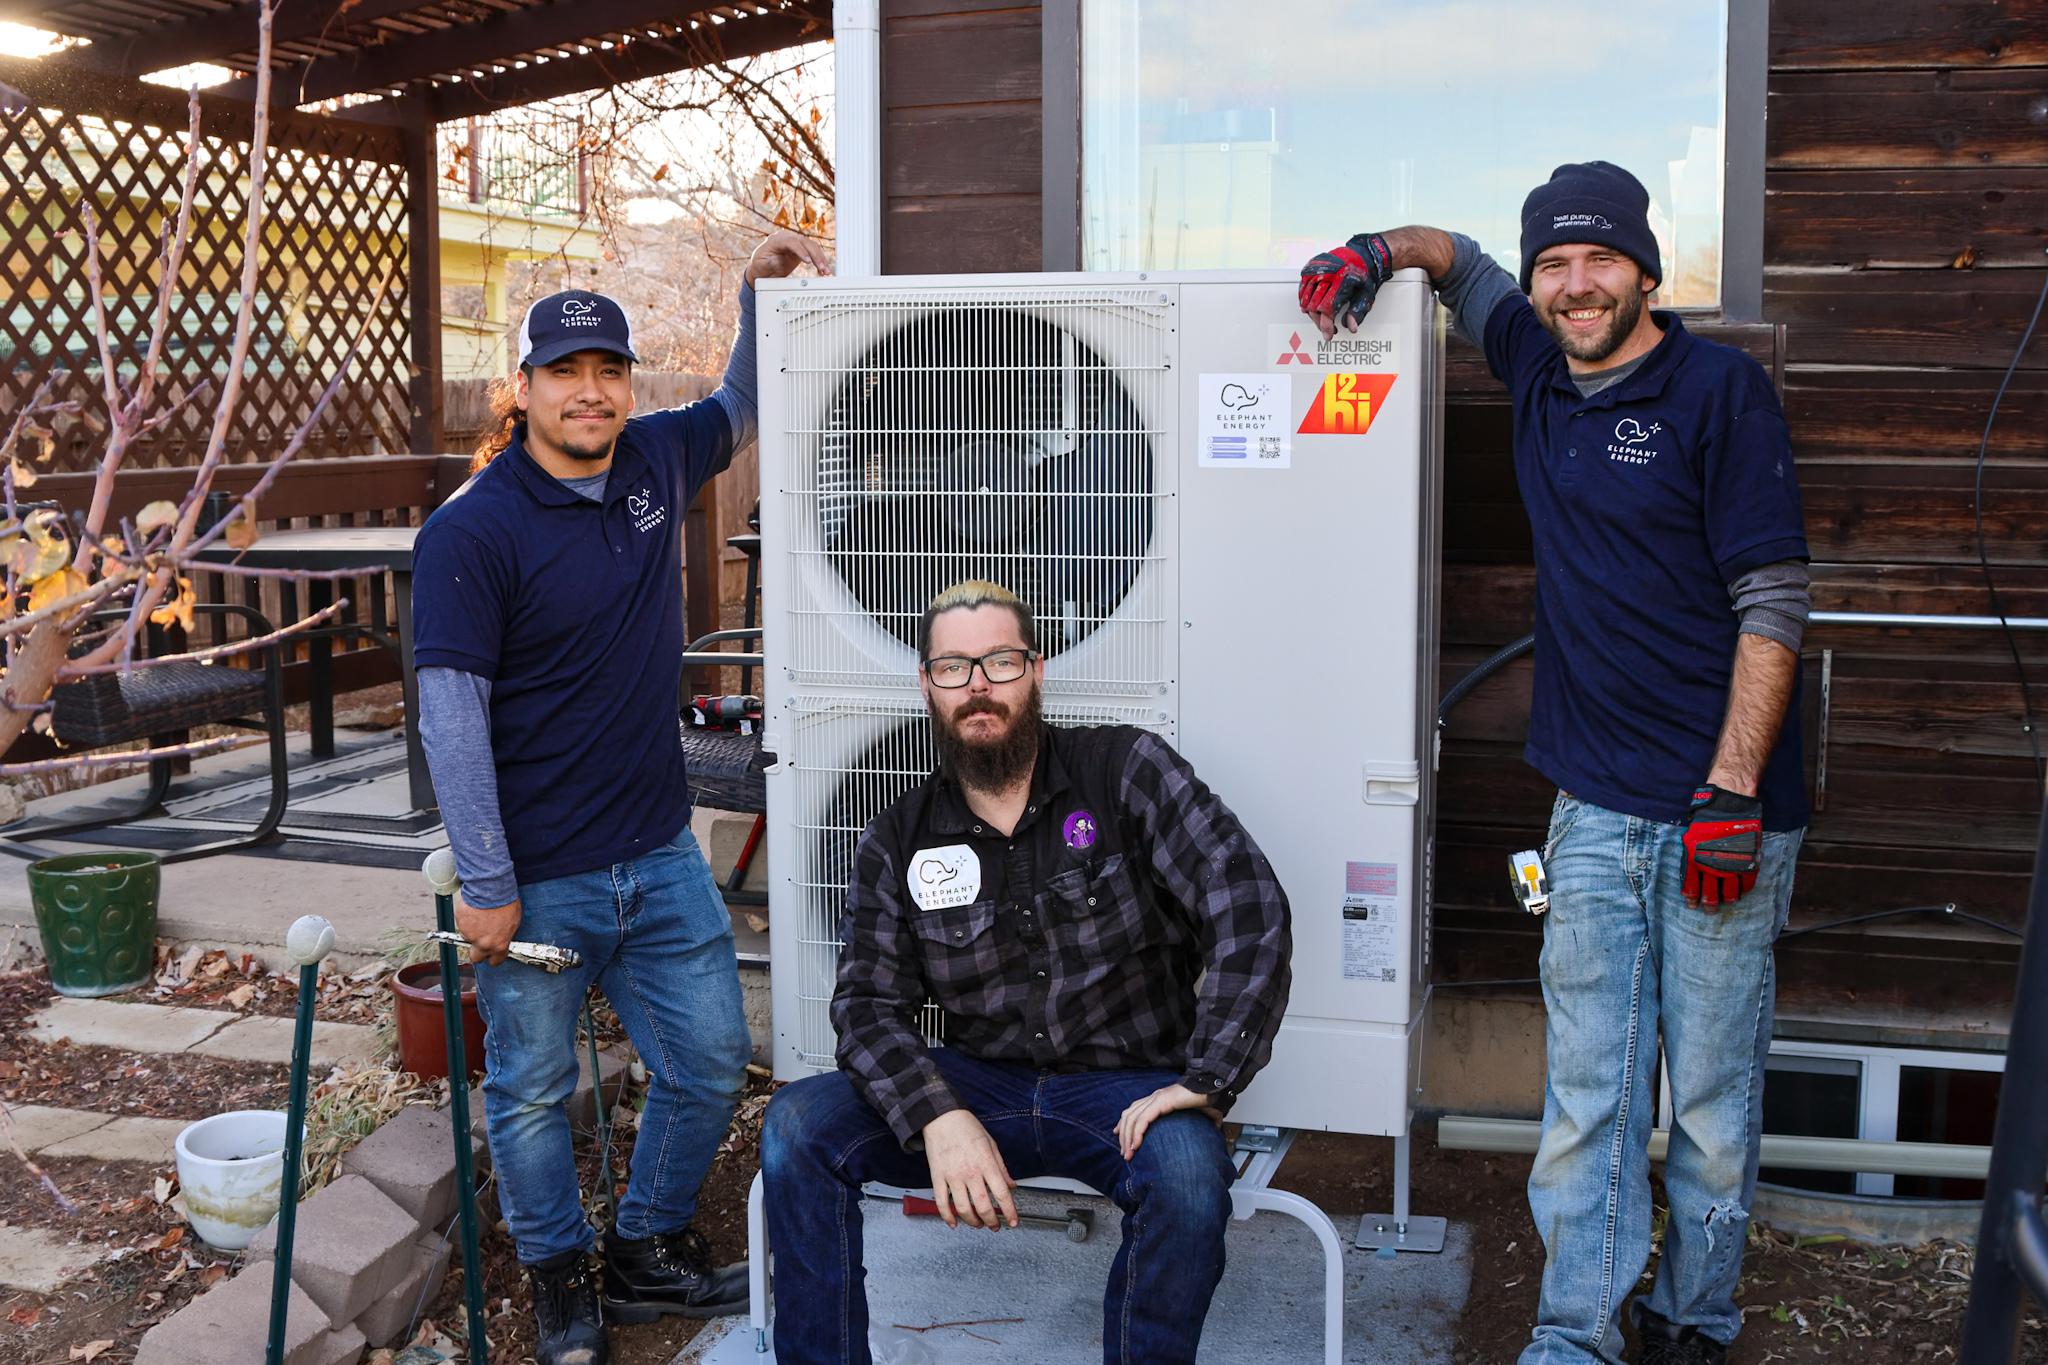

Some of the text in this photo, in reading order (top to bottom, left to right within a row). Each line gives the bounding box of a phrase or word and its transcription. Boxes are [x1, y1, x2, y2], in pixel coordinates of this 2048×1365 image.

[1317, 340, 1392, 353] MITSUBISHI
[1317, 353, 1382, 366] ELECTRIC
[1223, 422, 1267, 430] ENERGY
[1607, 444, 1658, 459] ELEPHANT
[1611, 453, 1650, 465] ENERGY
[634, 506, 666, 529] ELEPHANT
[640, 514, 666, 533] ENERGY
[918, 885, 974, 899] ELEPHANT
[926, 895, 969, 907] ENERGY
